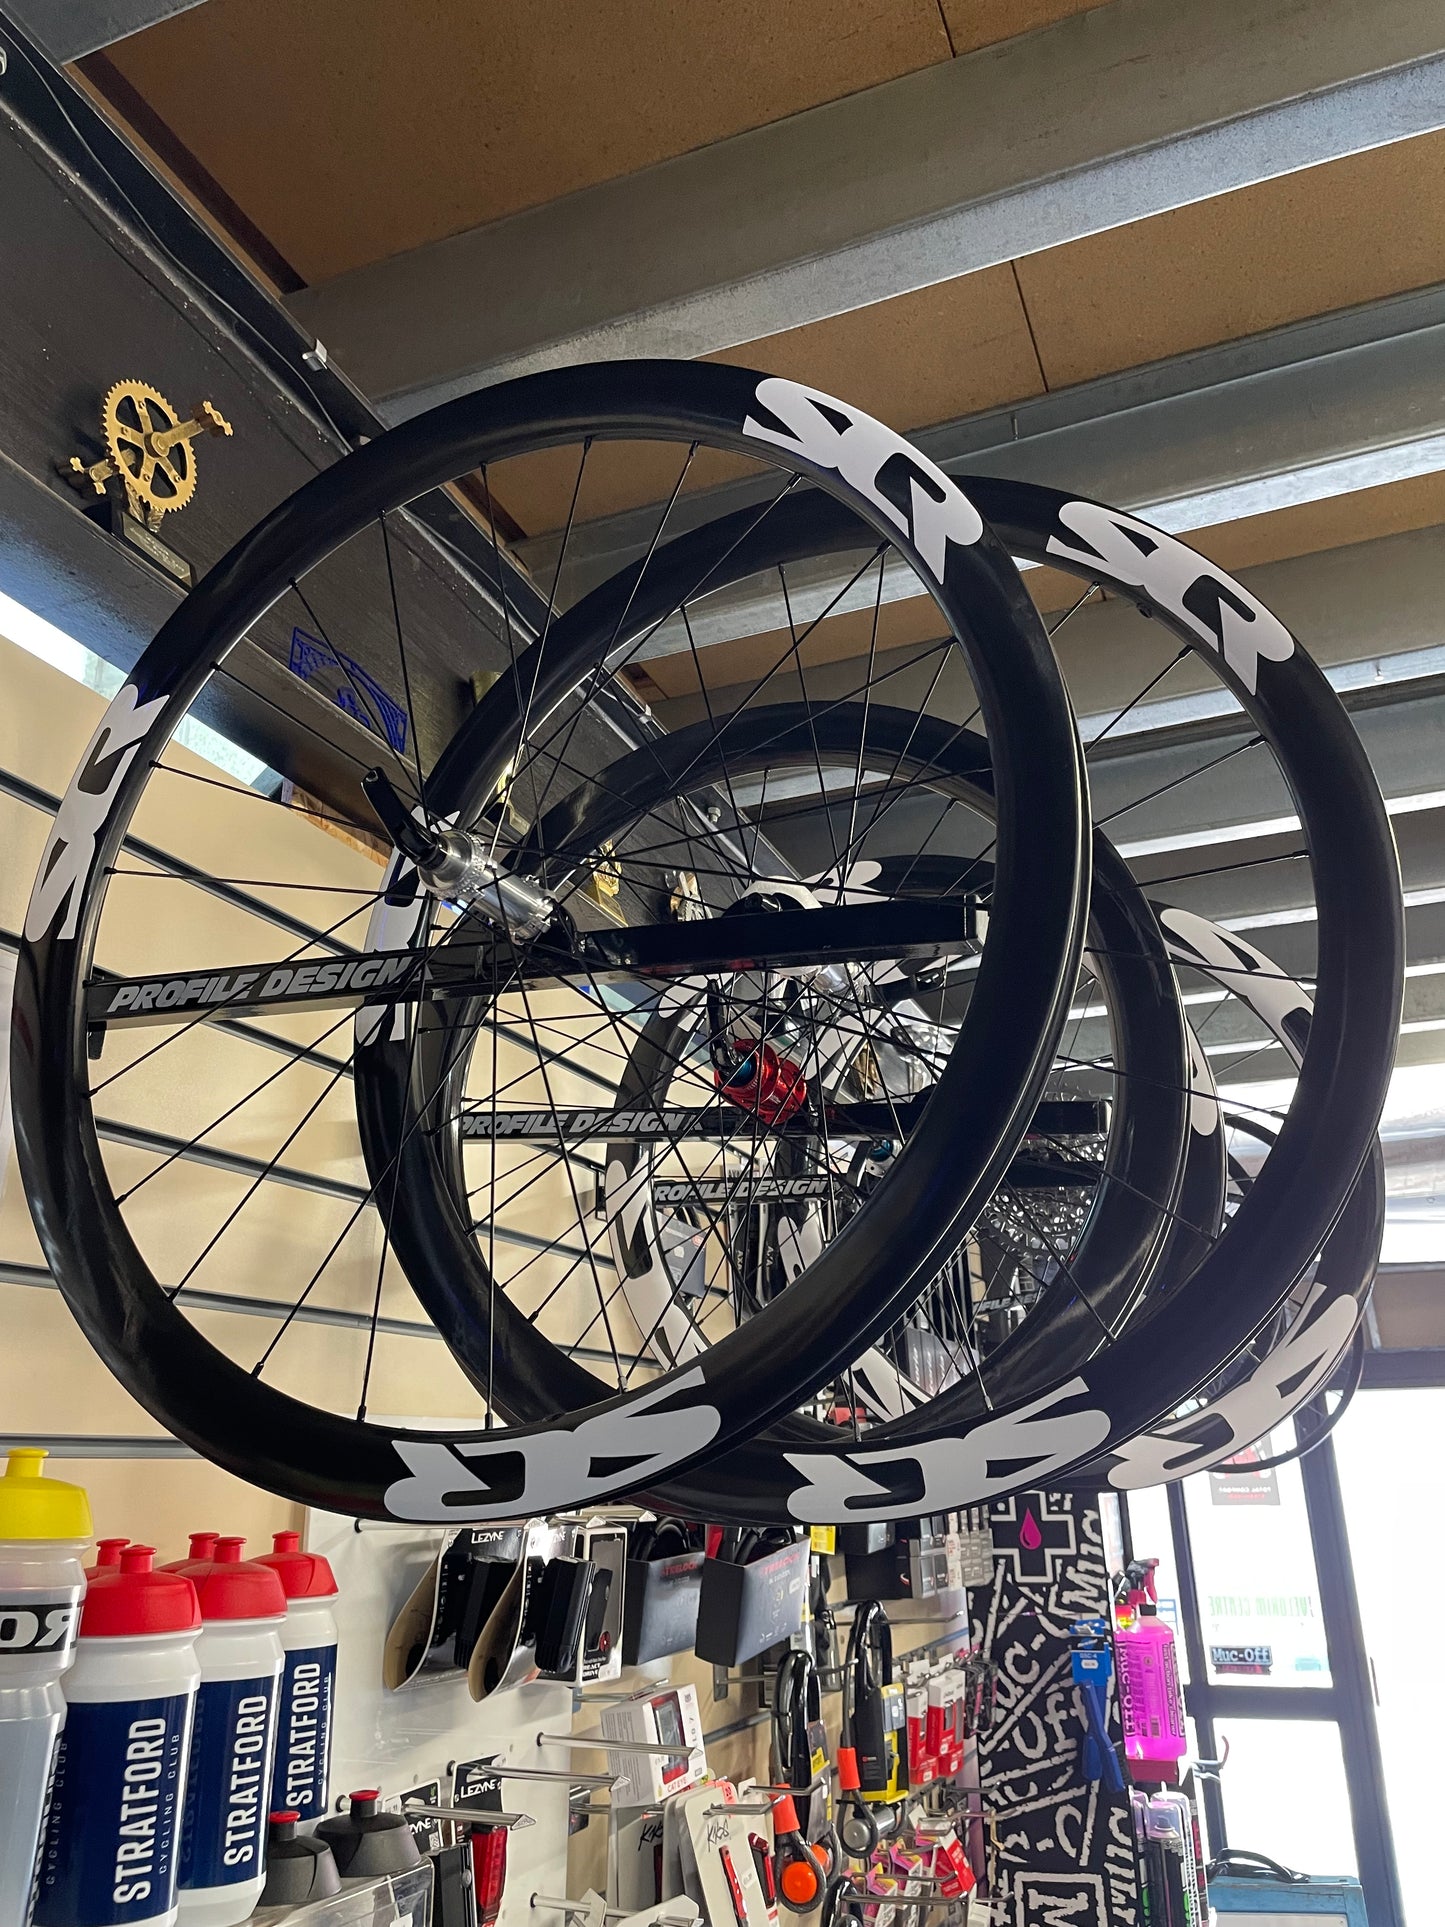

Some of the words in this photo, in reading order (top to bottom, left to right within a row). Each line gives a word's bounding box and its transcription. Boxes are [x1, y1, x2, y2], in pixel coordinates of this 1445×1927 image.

[107, 972, 261, 1013] PROFILE
[259, 956, 414, 997] DESIGN
[569, 1111, 685, 1133] DESIGN
[655, 1182, 732, 1202] ROFILE
[735, 1179, 829, 1198] DESIGN
[471, 1530, 504, 1544] LEZYNE
[1212, 1647, 1270, 1663] Muc-Off
[286, 1662, 321, 1808] STRATFORD
[223, 1695, 268, 1867] STRATFORD
[460, 1779, 497, 1799] LEZYNE
[112, 1717, 167, 1904] STRATFORD
[158, 1792, 174, 1875] CYCLING
[168, 1733, 181, 1780] CLUB
[45, 1801, 62, 1886] CYCLING
[409, 1817, 432, 1836] ZYNE
